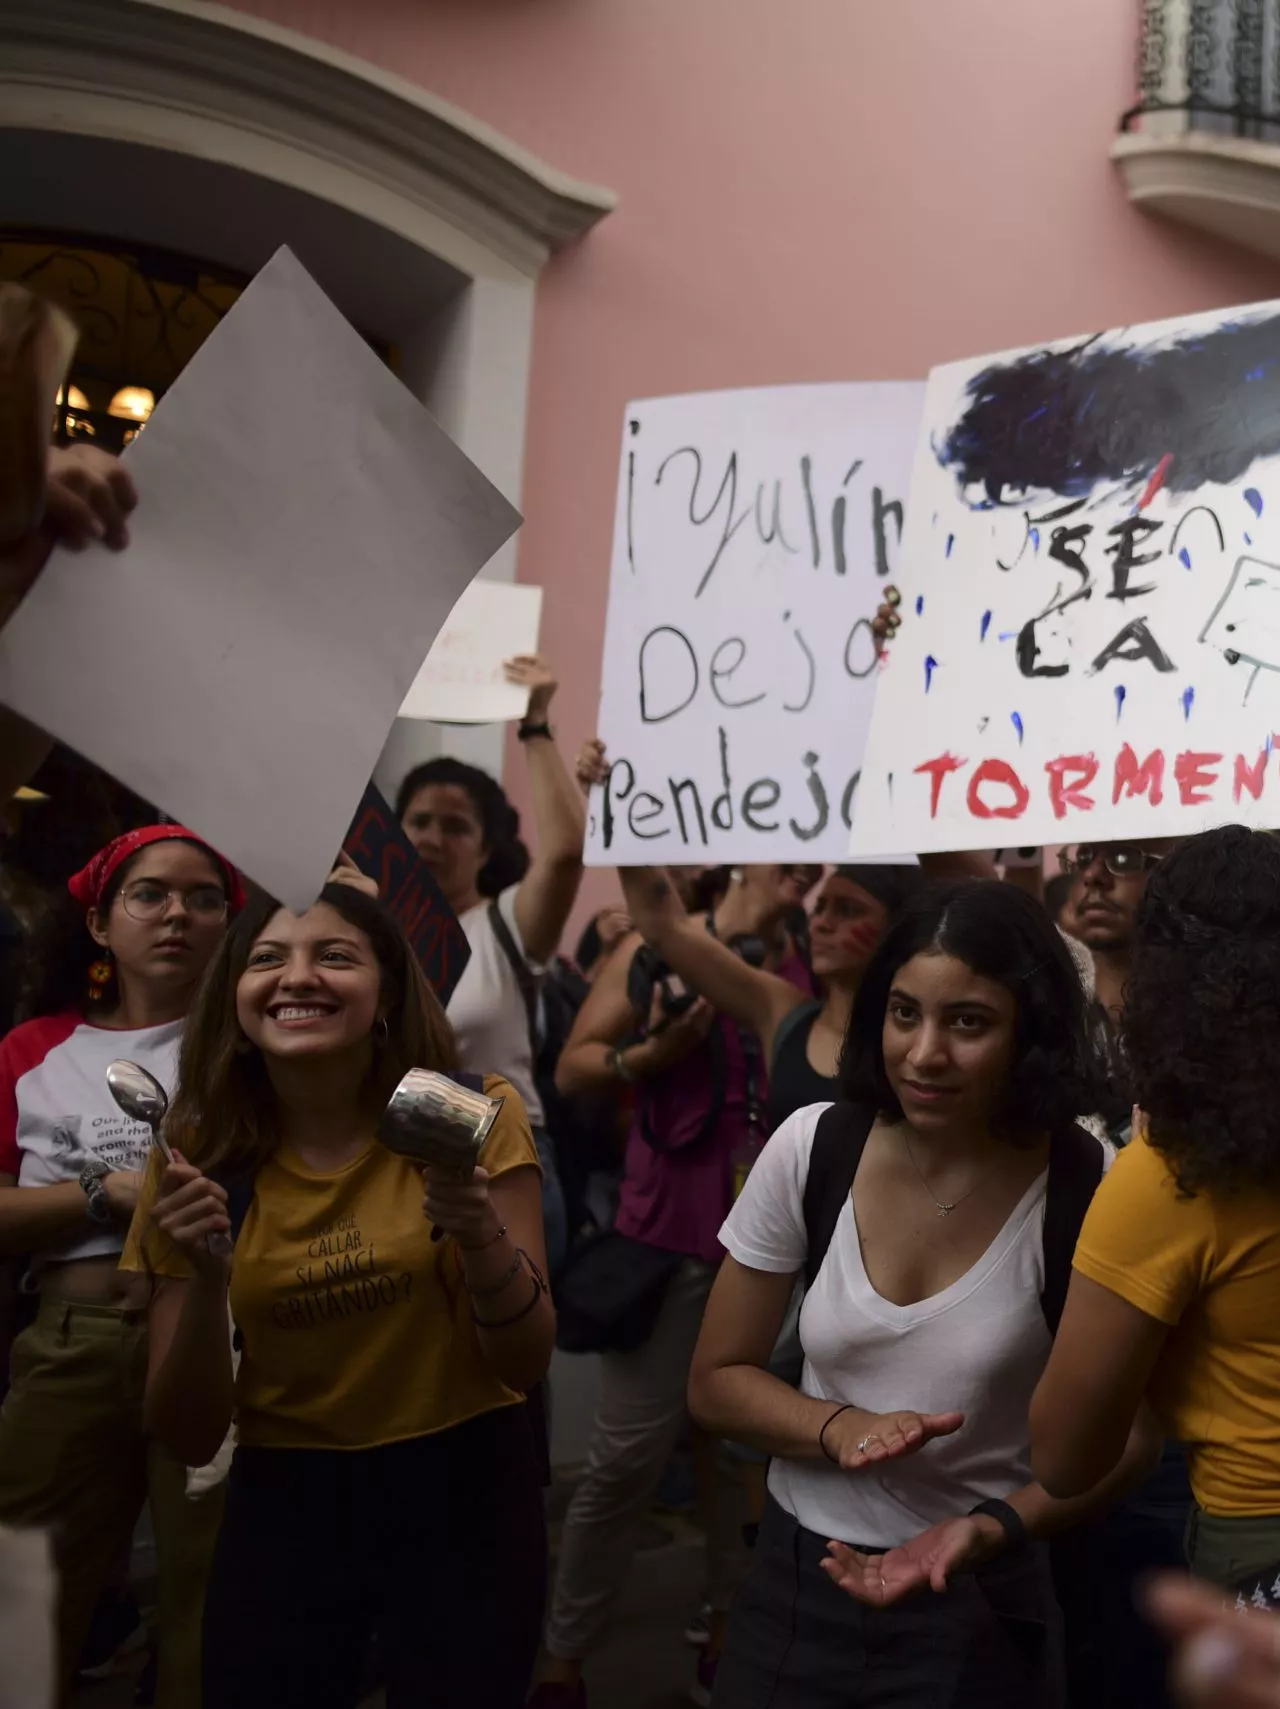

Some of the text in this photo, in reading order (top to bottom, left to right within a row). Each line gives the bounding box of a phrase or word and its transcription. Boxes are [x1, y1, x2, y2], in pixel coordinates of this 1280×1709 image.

[1015, 616, 1179, 678] LA
[296, 1242, 376, 1290] SI NACÍ
[308, 1230, 363, 1259] CALLAR
